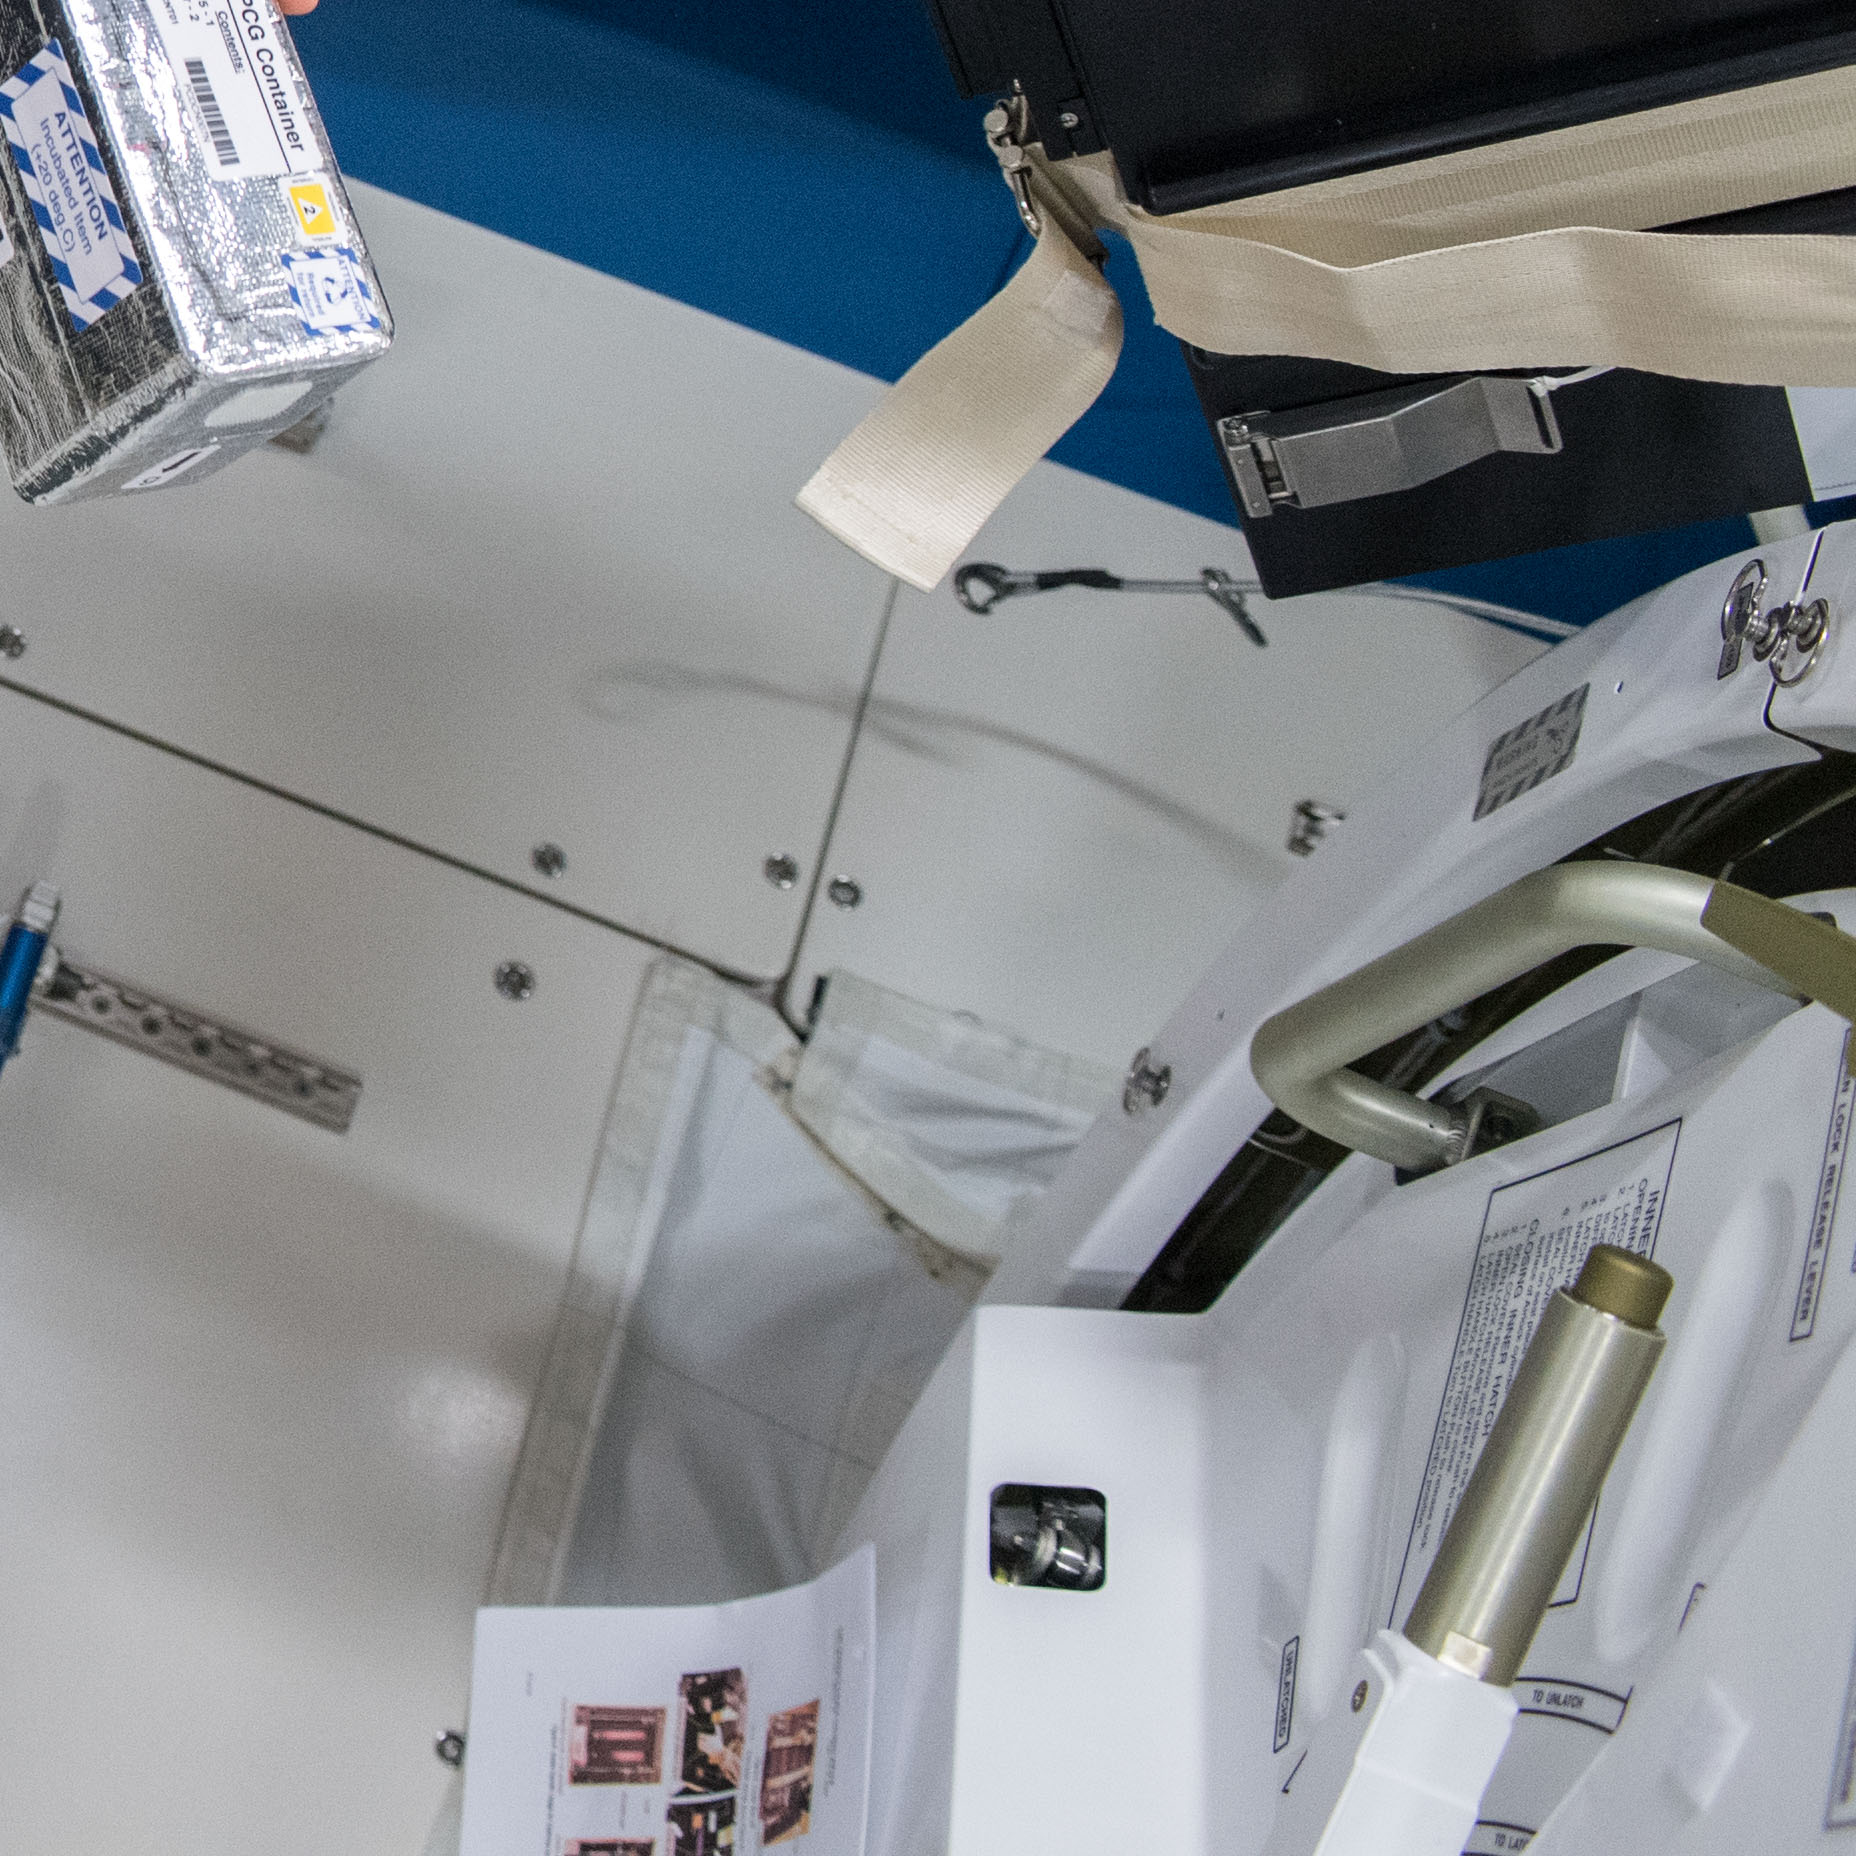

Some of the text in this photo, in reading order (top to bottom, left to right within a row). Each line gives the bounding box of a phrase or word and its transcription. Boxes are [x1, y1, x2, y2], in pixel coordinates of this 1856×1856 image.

[187, 11, 200, 24] 2
[196, 0, 208, 9] 5
[204, 19, 215, 28] 1
[214, 7, 248, 76] Contents:
[252, 45, 307, 156] Container
[29, 142, 77, 253] (+20 deg.C)
[38, 118, 94, 254] Incubated Item
[53, 109, 109, 240] ATTENTION
[303, 204, 316, 216] 2
[305, 271, 327, 316] Required
[336, 257, 366, 321] ATTENTION
[1829, 1102, 1846, 1153] LOCK
[1811, 1164, 1836, 1249] RELEASE
[1798, 1259, 1818, 1322] LEVER
[1478, 1217, 1540, 1438] CLOSING INNER HATCH
[1278, 1650, 1294, 1737] UNLATCHED
[1532, 1689, 1584, 1708] TO UNLATCH
[1494, 1832, 1505, 1847] TO
